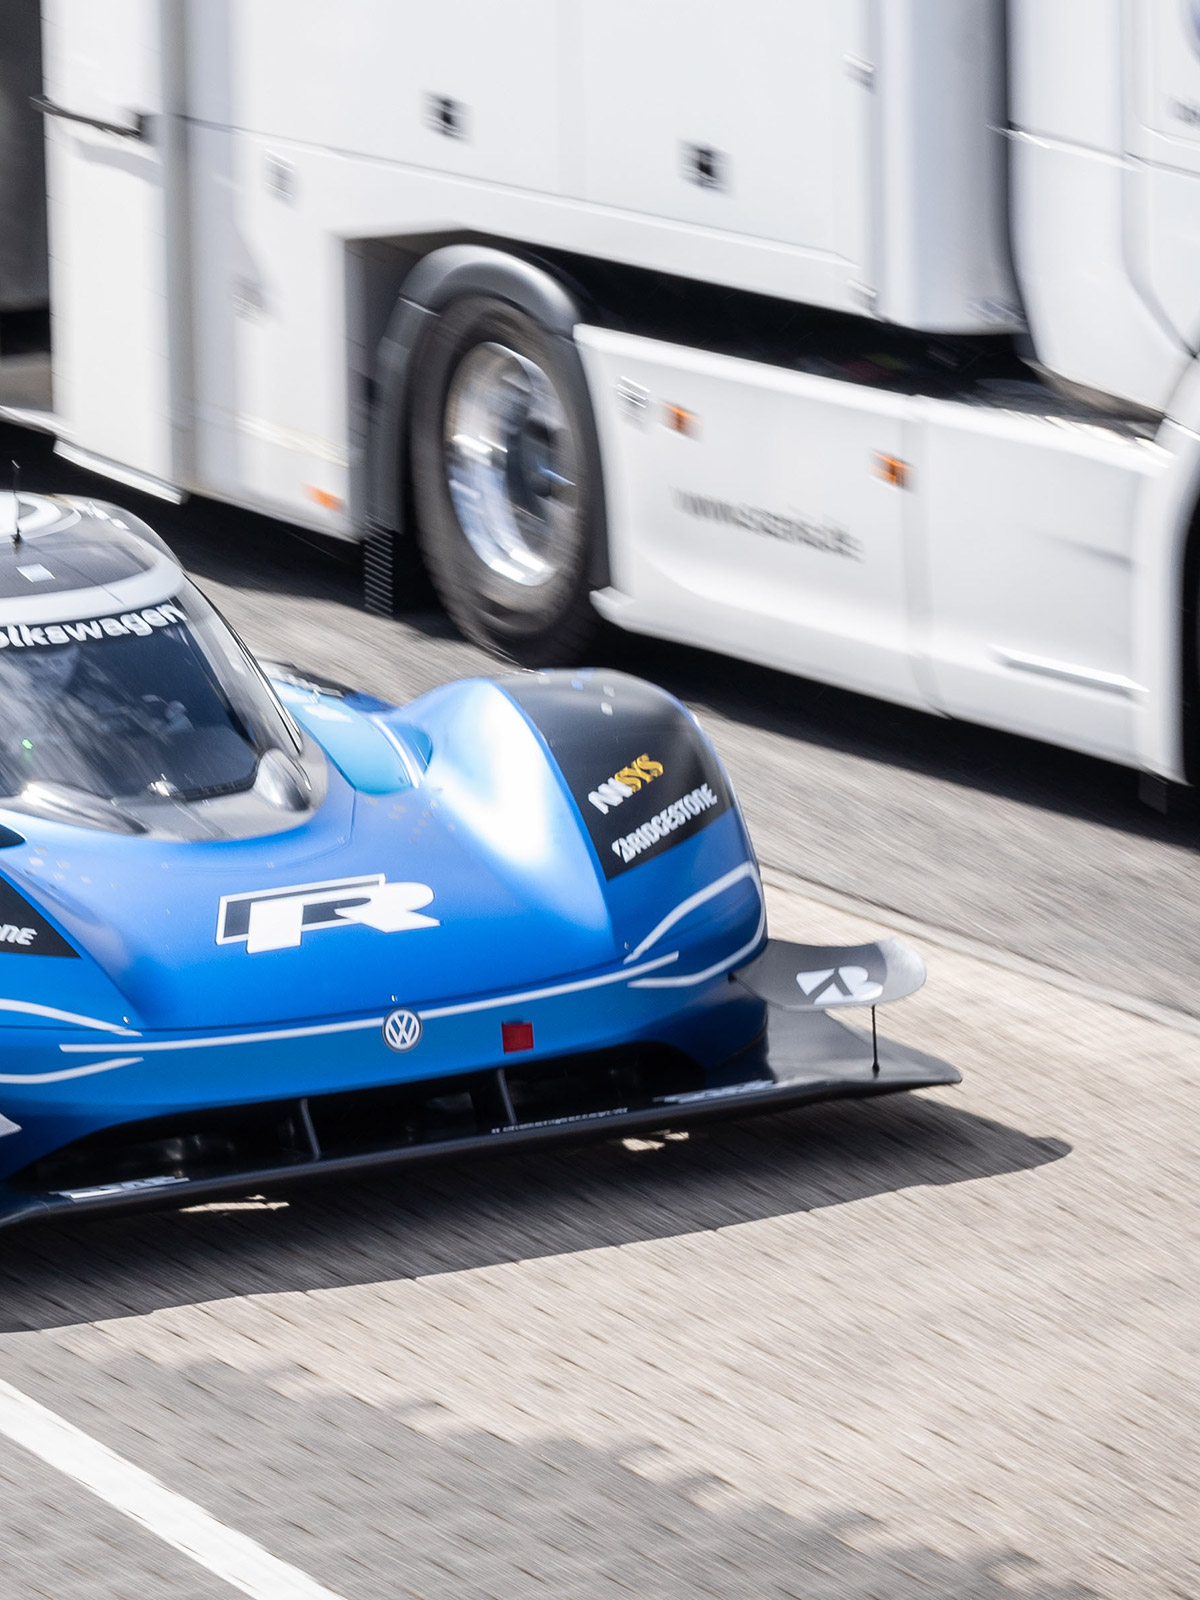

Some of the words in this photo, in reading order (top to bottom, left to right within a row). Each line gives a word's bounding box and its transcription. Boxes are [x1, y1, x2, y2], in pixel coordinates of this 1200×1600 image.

[588, 753, 664, 815] ANSYS
[611, 783, 718, 863] BRIDGESTONE
[215, 873, 441, 954] R
